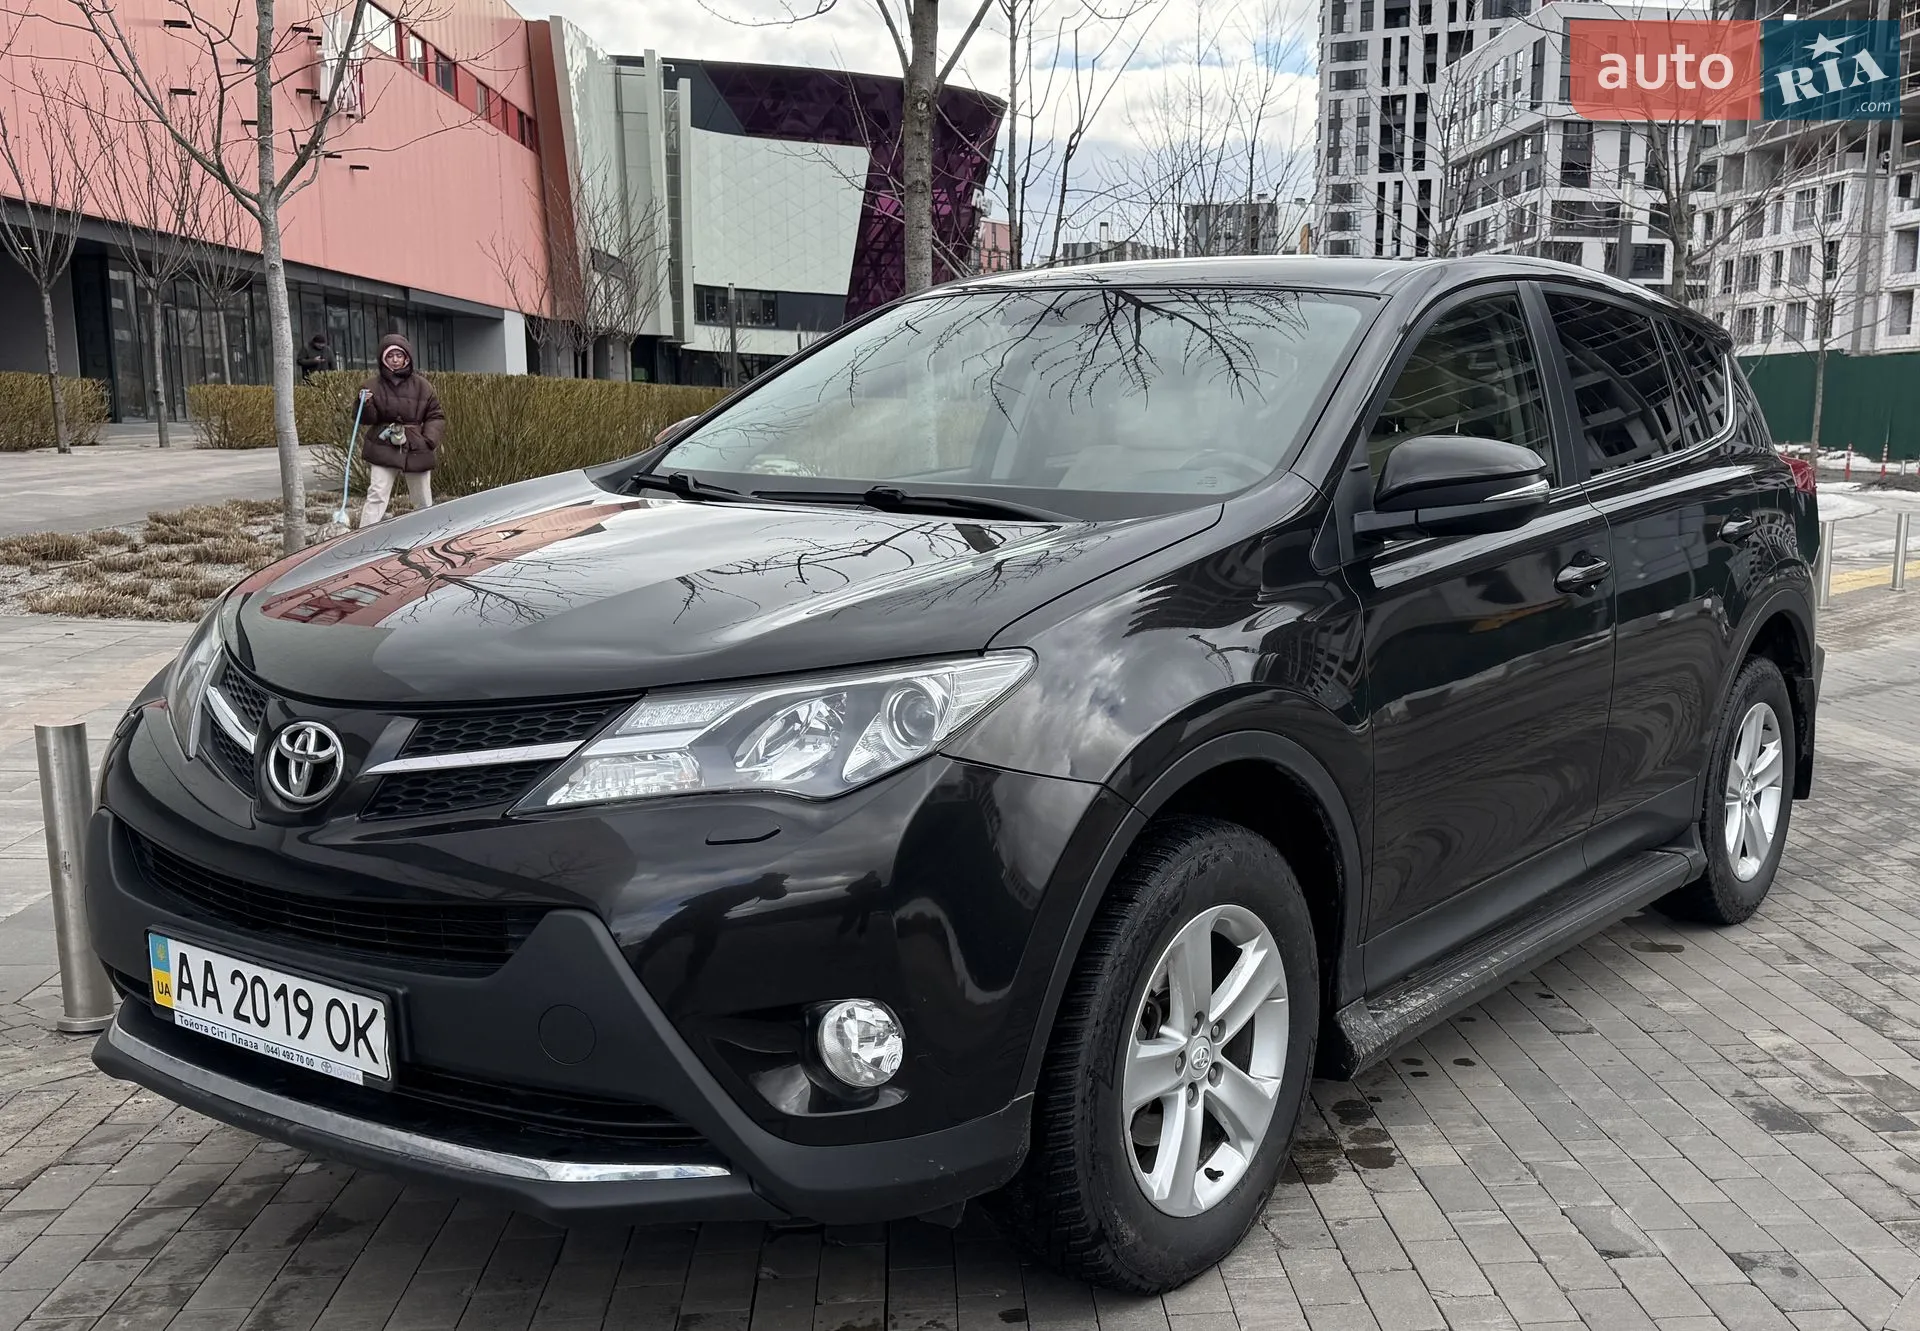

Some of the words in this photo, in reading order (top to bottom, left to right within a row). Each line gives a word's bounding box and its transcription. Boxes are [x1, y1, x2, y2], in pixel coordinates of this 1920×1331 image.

[157, 981, 172, 998] UA
[177, 952, 224, 1014] AA
[230, 969, 314, 1041] 2019
[325, 998, 380, 1065] OK
[178, 1014, 209, 1033] Тойота
[210, 1026, 227, 1040] Сіті
[231, 1032, 259, 1050] Плаза
[263, 1043, 281, 1057] (044)
[282, 1050, 295, 1061] 492
